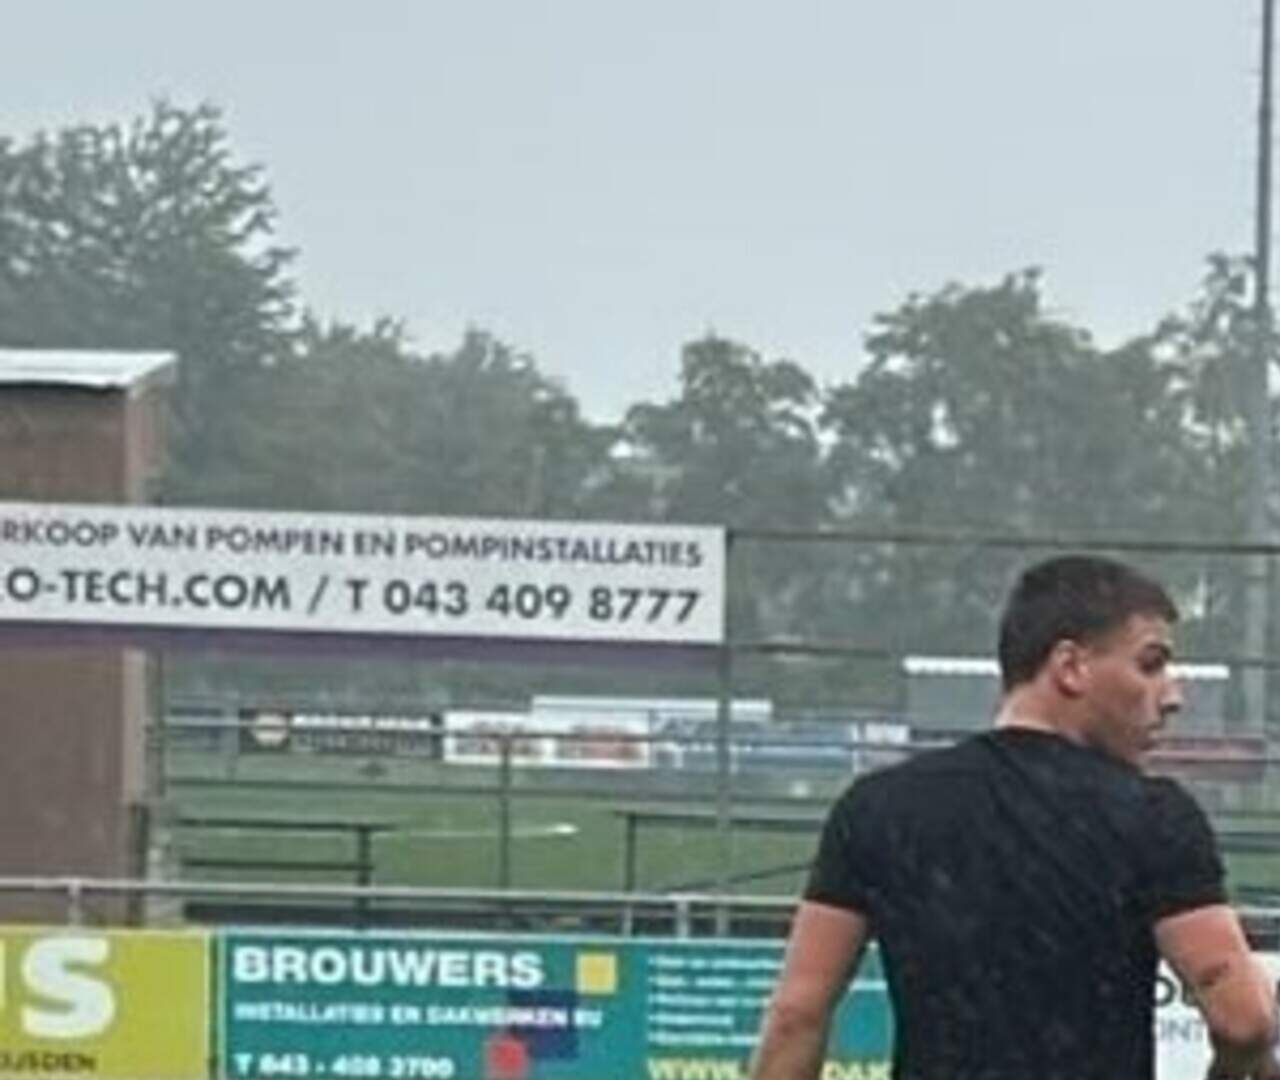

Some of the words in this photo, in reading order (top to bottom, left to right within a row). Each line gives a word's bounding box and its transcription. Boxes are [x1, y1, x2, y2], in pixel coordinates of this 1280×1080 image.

[127, 523, 198, 549] VAN
[205, 526, 345, 555] POMPEN
[353, 532, 396, 556] EN
[404, 533, 702, 568] POMPINSTALLATIES
[4, 567, 292, 611] O-TECH.COM
[346, 579, 369, 611] T
[383, 579, 469, 617] 043
[486, 583, 572, 620] 409
[588, 586, 700, 623] 8777
[233, 946, 545, 988] BROUWERS
